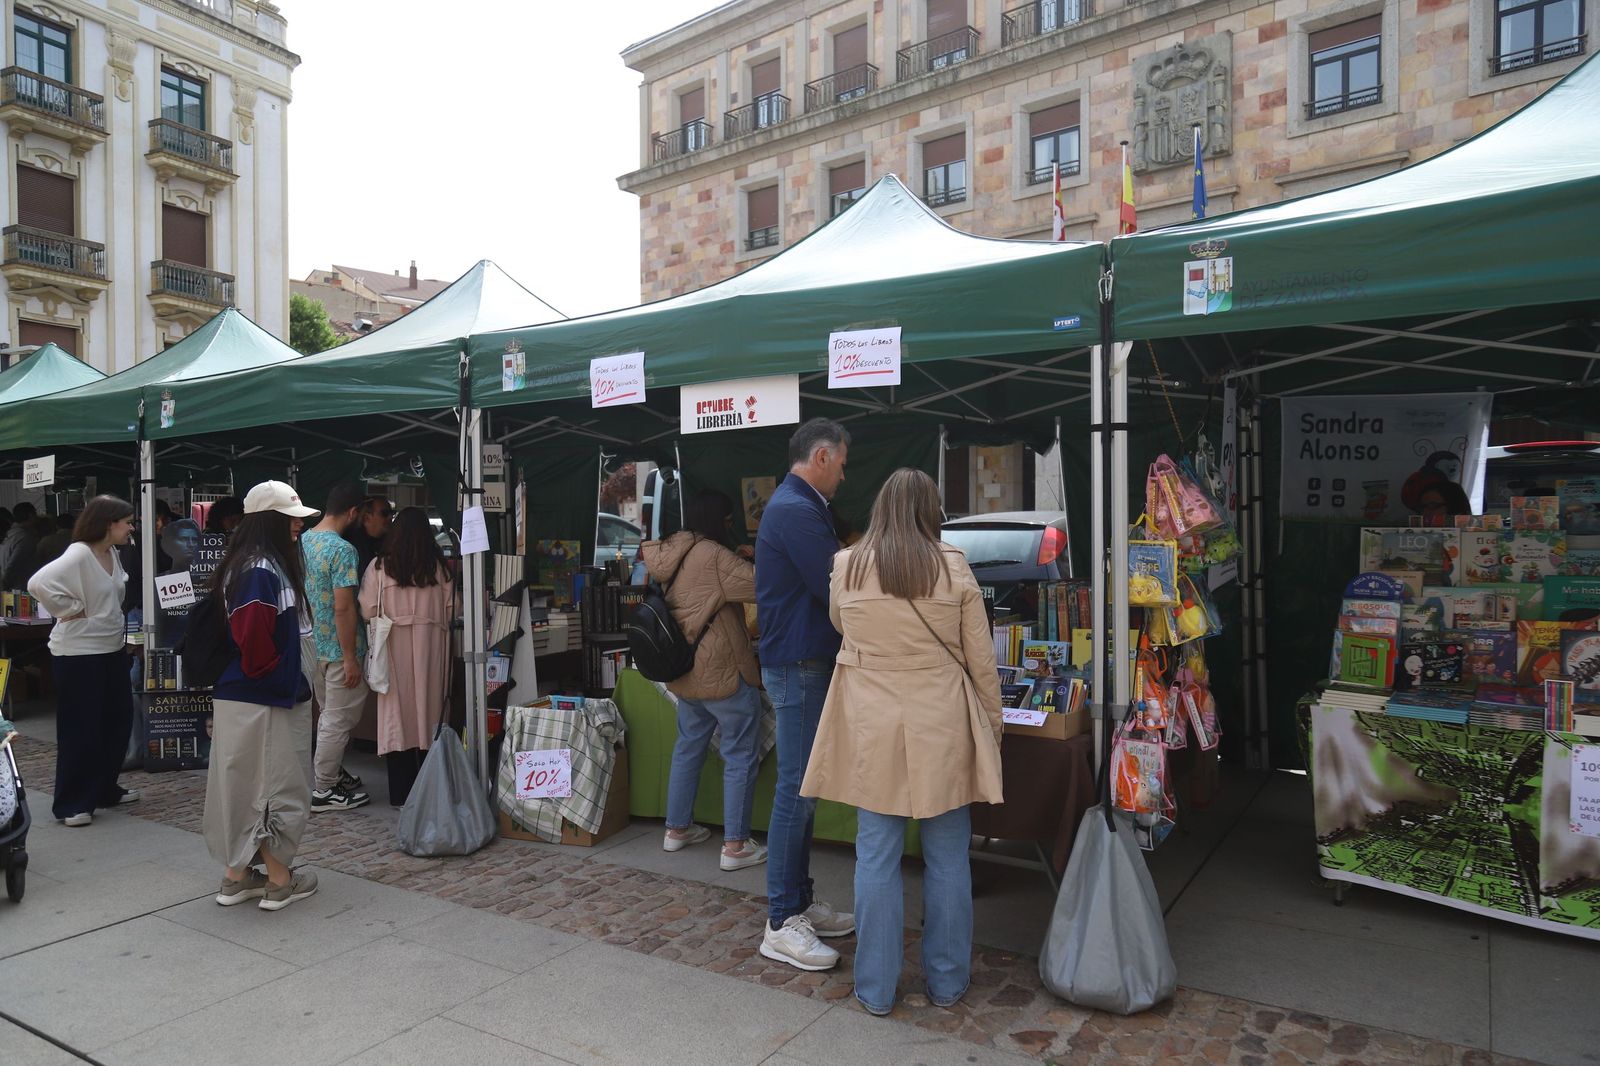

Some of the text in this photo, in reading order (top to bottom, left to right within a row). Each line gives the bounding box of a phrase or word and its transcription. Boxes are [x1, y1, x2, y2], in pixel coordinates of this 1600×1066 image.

[1240, 267, 1369, 292] AYUNTAMIENTO
[1273, 286, 1368, 307] ZAMORA
[834, 353, 861, 373] 10%
[594, 378, 615, 398] 10%
[696, 410, 743, 430] LIBRERÍA
[1300, 411, 1384, 434] Sandra
[1299, 438, 1380, 461] Alonso
[203, 538, 222, 546] LOS
[1400, 536, 1428, 548] LEO
[199, 550, 228, 560] TRES
[190, 564, 218, 572] MUN
[160, 583, 191, 596] 10%
[1581, 586, 1600, 596] hab
[162, 593, 193, 602] Descuento
[156, 695, 213, 705] SANTIAGO
[148, 704, 213, 714] POSTEGUILL
[523, 768, 561, 791] 10%
[1580, 805, 1595, 813] LAS
